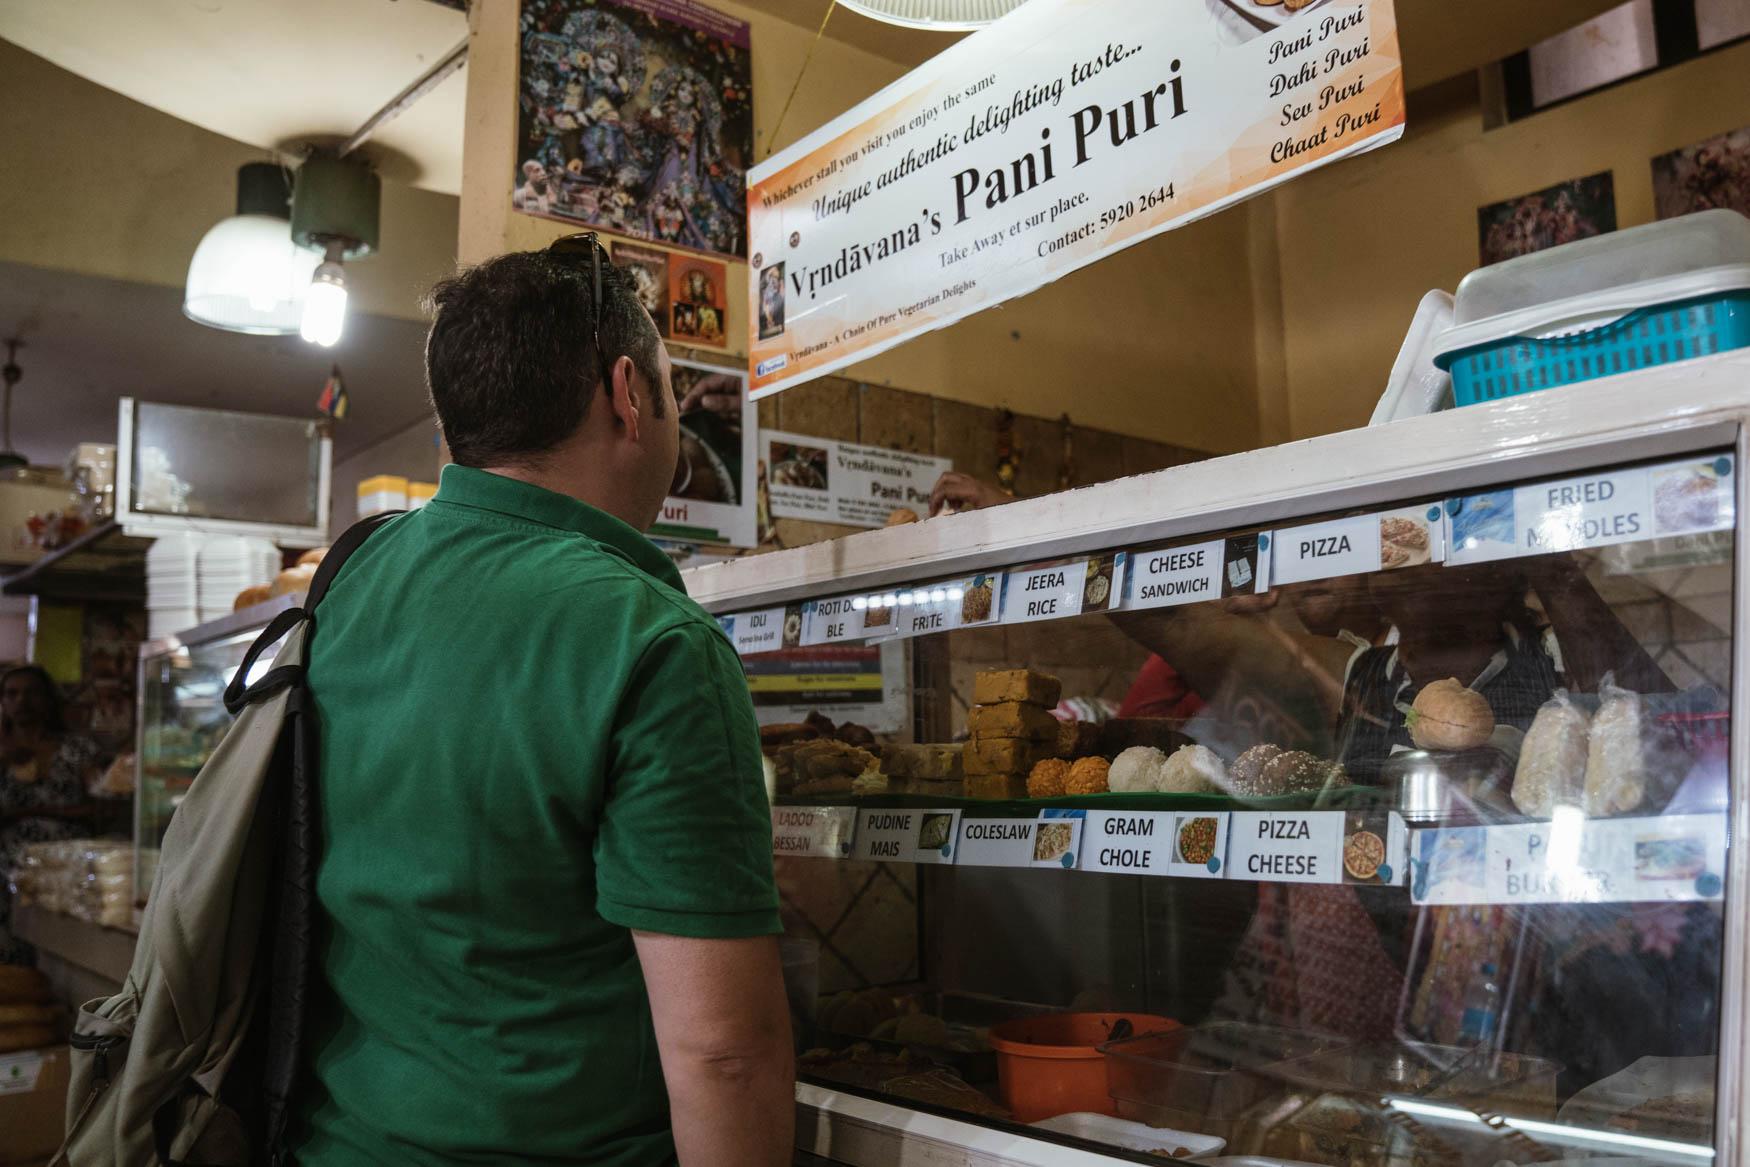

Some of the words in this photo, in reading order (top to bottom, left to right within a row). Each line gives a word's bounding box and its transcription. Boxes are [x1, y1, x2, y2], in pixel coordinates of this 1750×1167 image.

[1268, 33, 1312, 64] Pani
[1318, 4, 1365, 42] Puri
[1269, 61, 1318, 98] Dahi
[1324, 37, 1370, 74] Puri
[1280, 102, 1313, 127] Sev
[1318, 75, 1365, 111] Puri
[763, 175, 813, 209] Whichever
[816, 161, 838, 184] stall
[839, 153, 859, 174] you
[861, 137, 883, 157] visit
[886, 125, 906, 146] you
[909, 106, 939, 131] enjoy
[943, 95, 961, 110] the
[965, 73, 996, 98] same
[952, 127, 1056, 226] Pani
[1069, 59, 1188, 169] Puri
[1270, 126, 1328, 164] Chaat
[1334, 103, 1381, 139] Puri
[812, 181, 871, 222] Unique
[877, 134, 957, 190] authentic
[963, 75, 1064, 144] delighting
[938, 243, 968, 268] Take
[970, 229, 1006, 256] Away
[1009, 221, 1021, 236] et
[1024, 213, 1047, 231] sur
[1050, 191, 1089, 222] place.
[1037, 220, 1096, 258] Contact:
[1100, 203, 1134, 230] 5920
[1139, 182, 1175, 213] 2644
[843, 324, 865, 340] Chain
[866, 318, 878, 333] Of
[878, 312, 897, 329] Pure
[898, 294, 941, 317] Vegetarian
[942, 278, 977, 301] Delights
[871, 481, 902, 499] Pani
[1547, 480, 1614, 508] FRIED
[664, 504, 688, 522] uri
[1527, 513, 1640, 548] NDLES
[1300, 534, 1352, 560] PIZZA
[1149, 550, 1205, 574] CHEESE
[1025, 571, 1065, 591] JEERA
[1140, 577, 1209, 599] SANDWICH
[818, 600, 841, 616] ROTI
[1027, 598, 1057, 617] RICE
[750, 614, 767, 628] IDLI
[827, 623, 844, 638] BLE
[912, 613, 943, 632] FRITE
[867, 815, 911, 831] PUDINE
[966, 824, 1032, 840] COLESLAW
[1104, 817, 1154, 837] GRAM
[1258, 820, 1311, 840] PIZZA
[773, 836, 810, 851] BESSAN
[869, 840, 900, 857] MAIS
[1099, 848, 1151, 868] CHOLE
[1247, 853, 1317, 875] CHEESE
